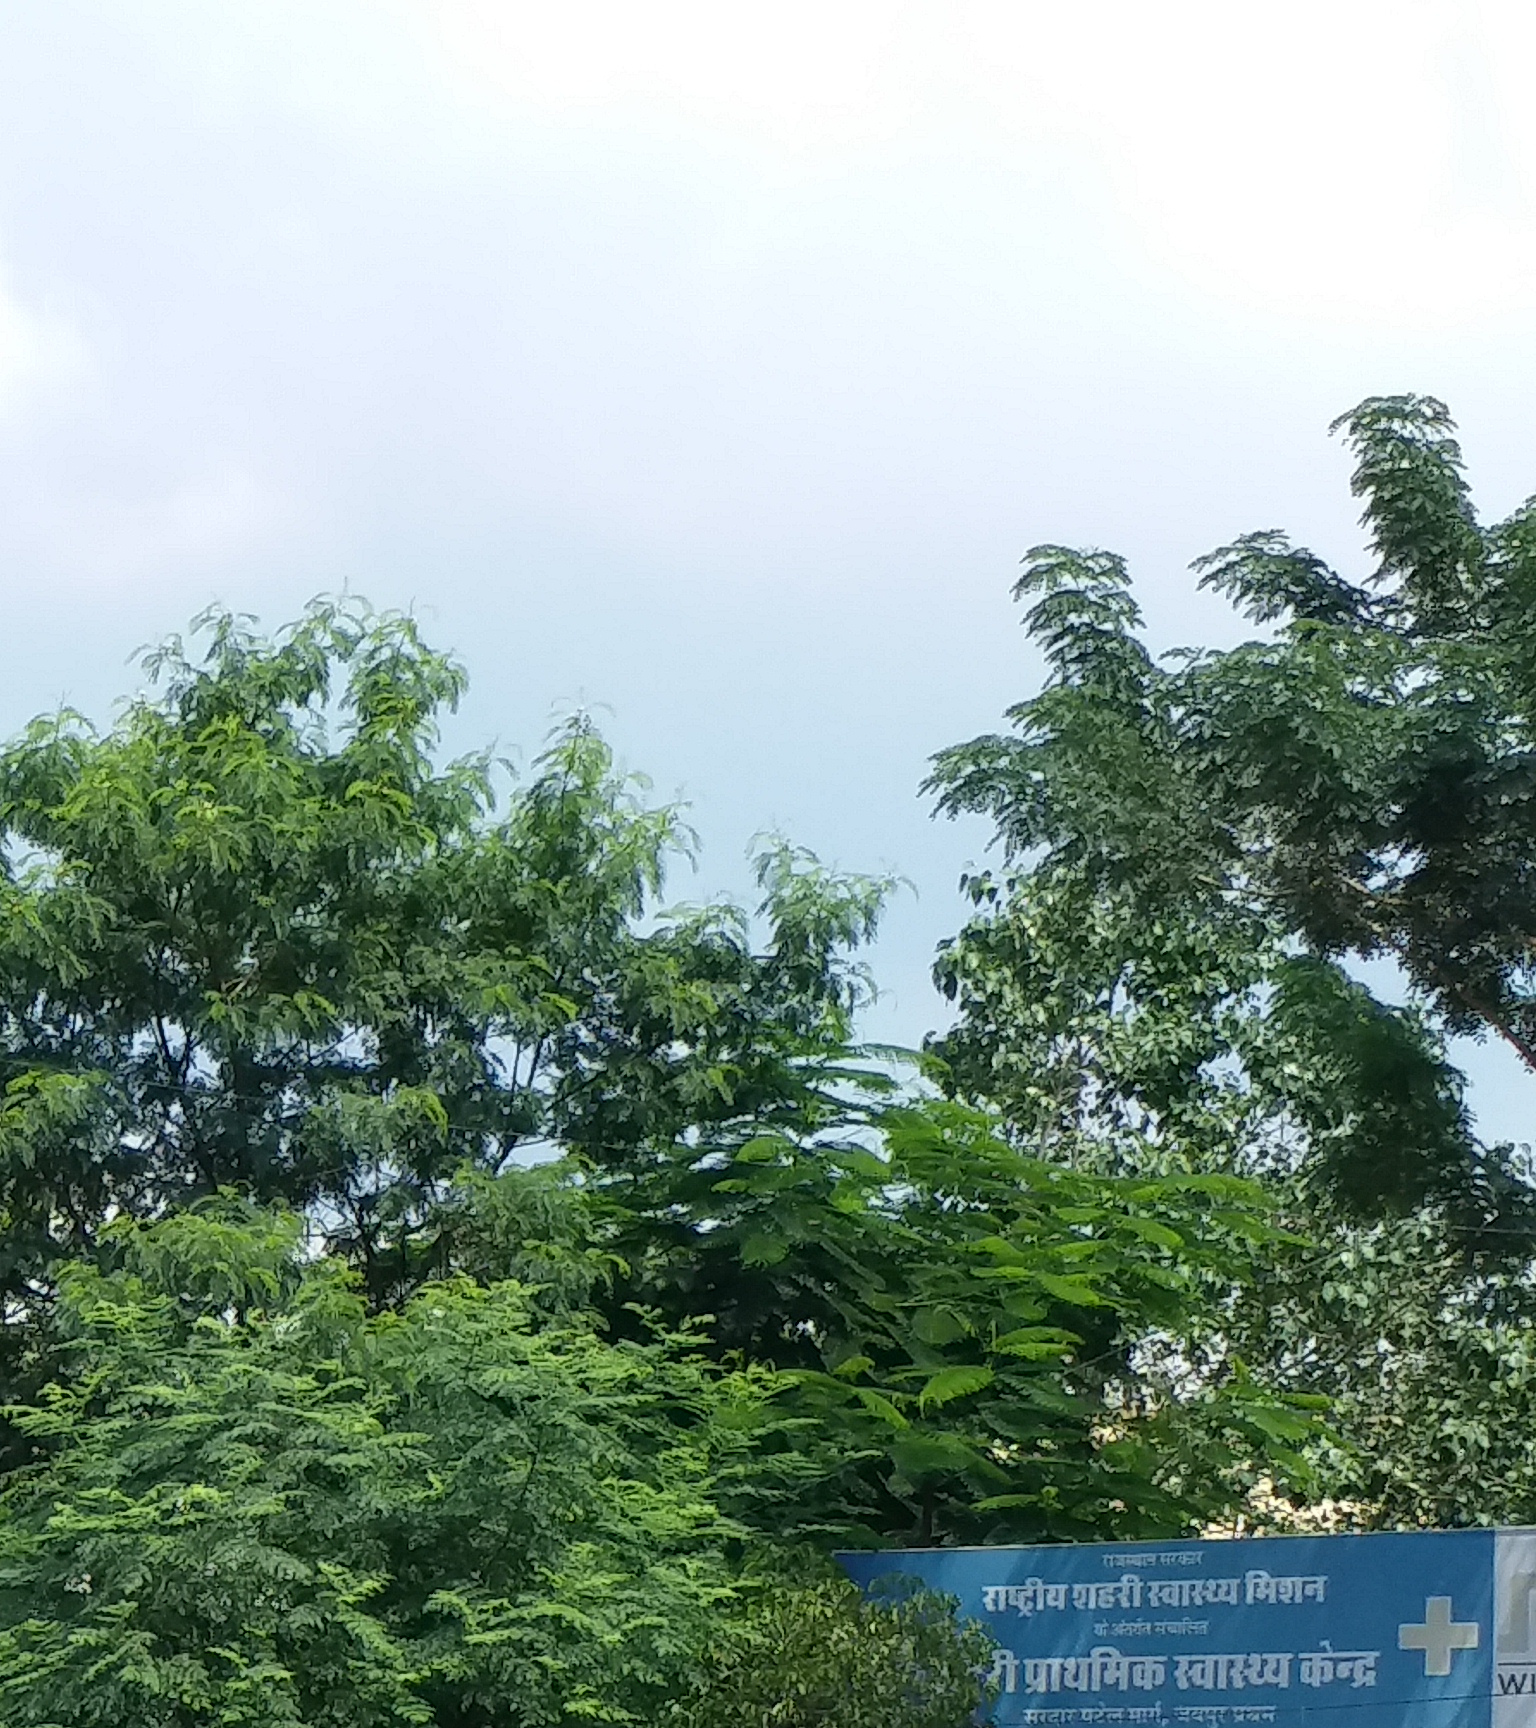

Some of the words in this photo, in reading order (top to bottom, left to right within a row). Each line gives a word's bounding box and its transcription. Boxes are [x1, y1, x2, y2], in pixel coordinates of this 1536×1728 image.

[981, 1576, 1069, 1617] राष्ट्रीय
[1071, 1573, 1144, 1610] शहरी
[1146, 1578, 1241, 1608] स्वास्थ्य
[1244, 1569, 1328, 1605] मिशन
[1023, 1646, 1167, 1694] प्राथमिक
[1173, 1653, 1294, 1690] स्वास्थ्य
[1298, 1640, 1381, 1689] केन्द्र
